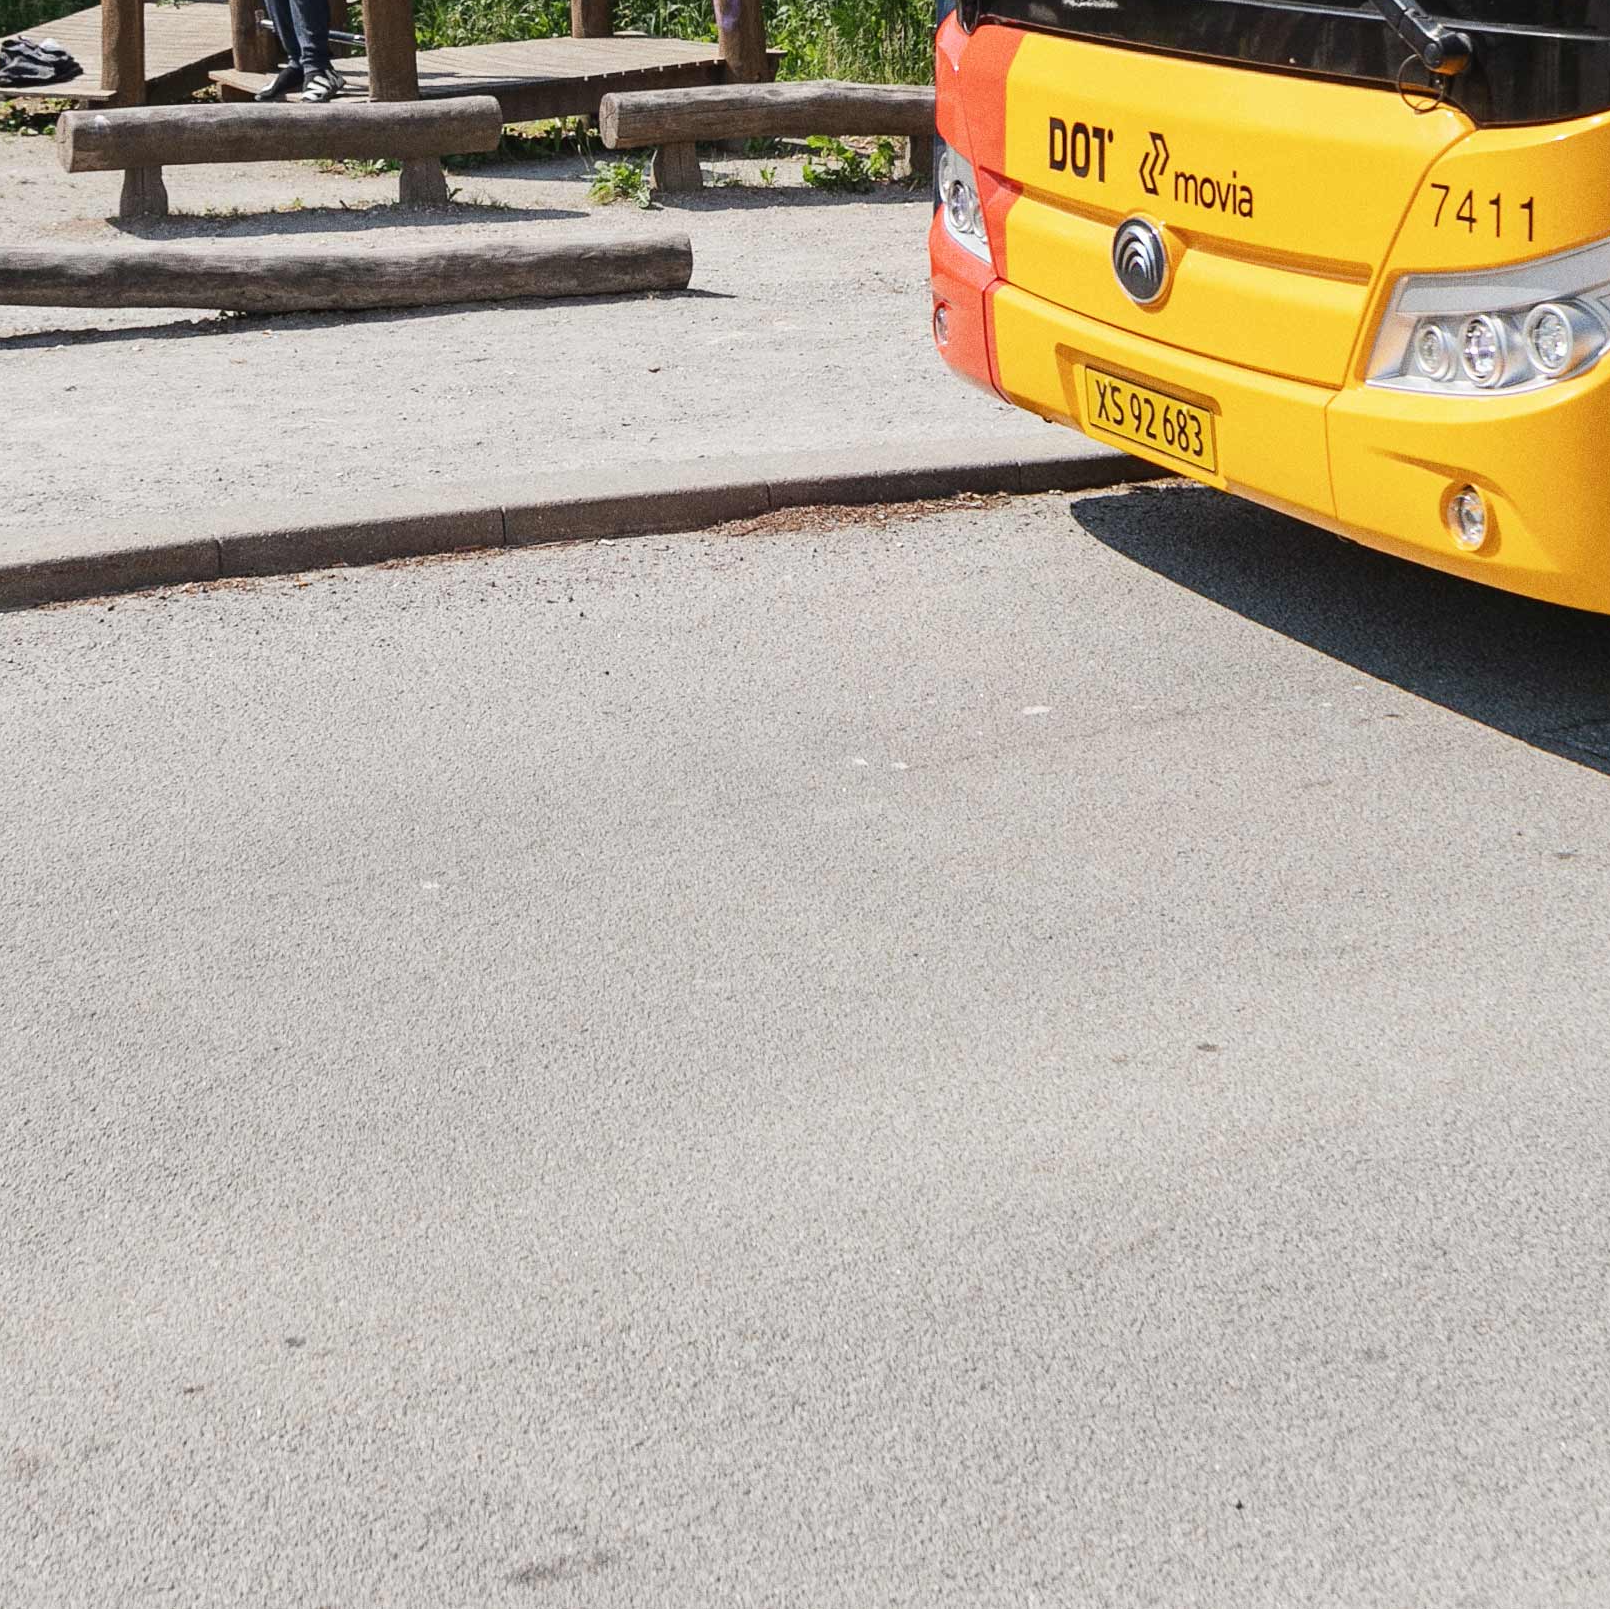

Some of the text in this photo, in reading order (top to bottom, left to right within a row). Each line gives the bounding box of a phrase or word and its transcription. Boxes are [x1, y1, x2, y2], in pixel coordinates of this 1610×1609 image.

[1049, 117, 1253, 218] DOT movia
[1431, 183, 1534, 242] 7411
[1095, 379, 1203, 456] XS 92 683
